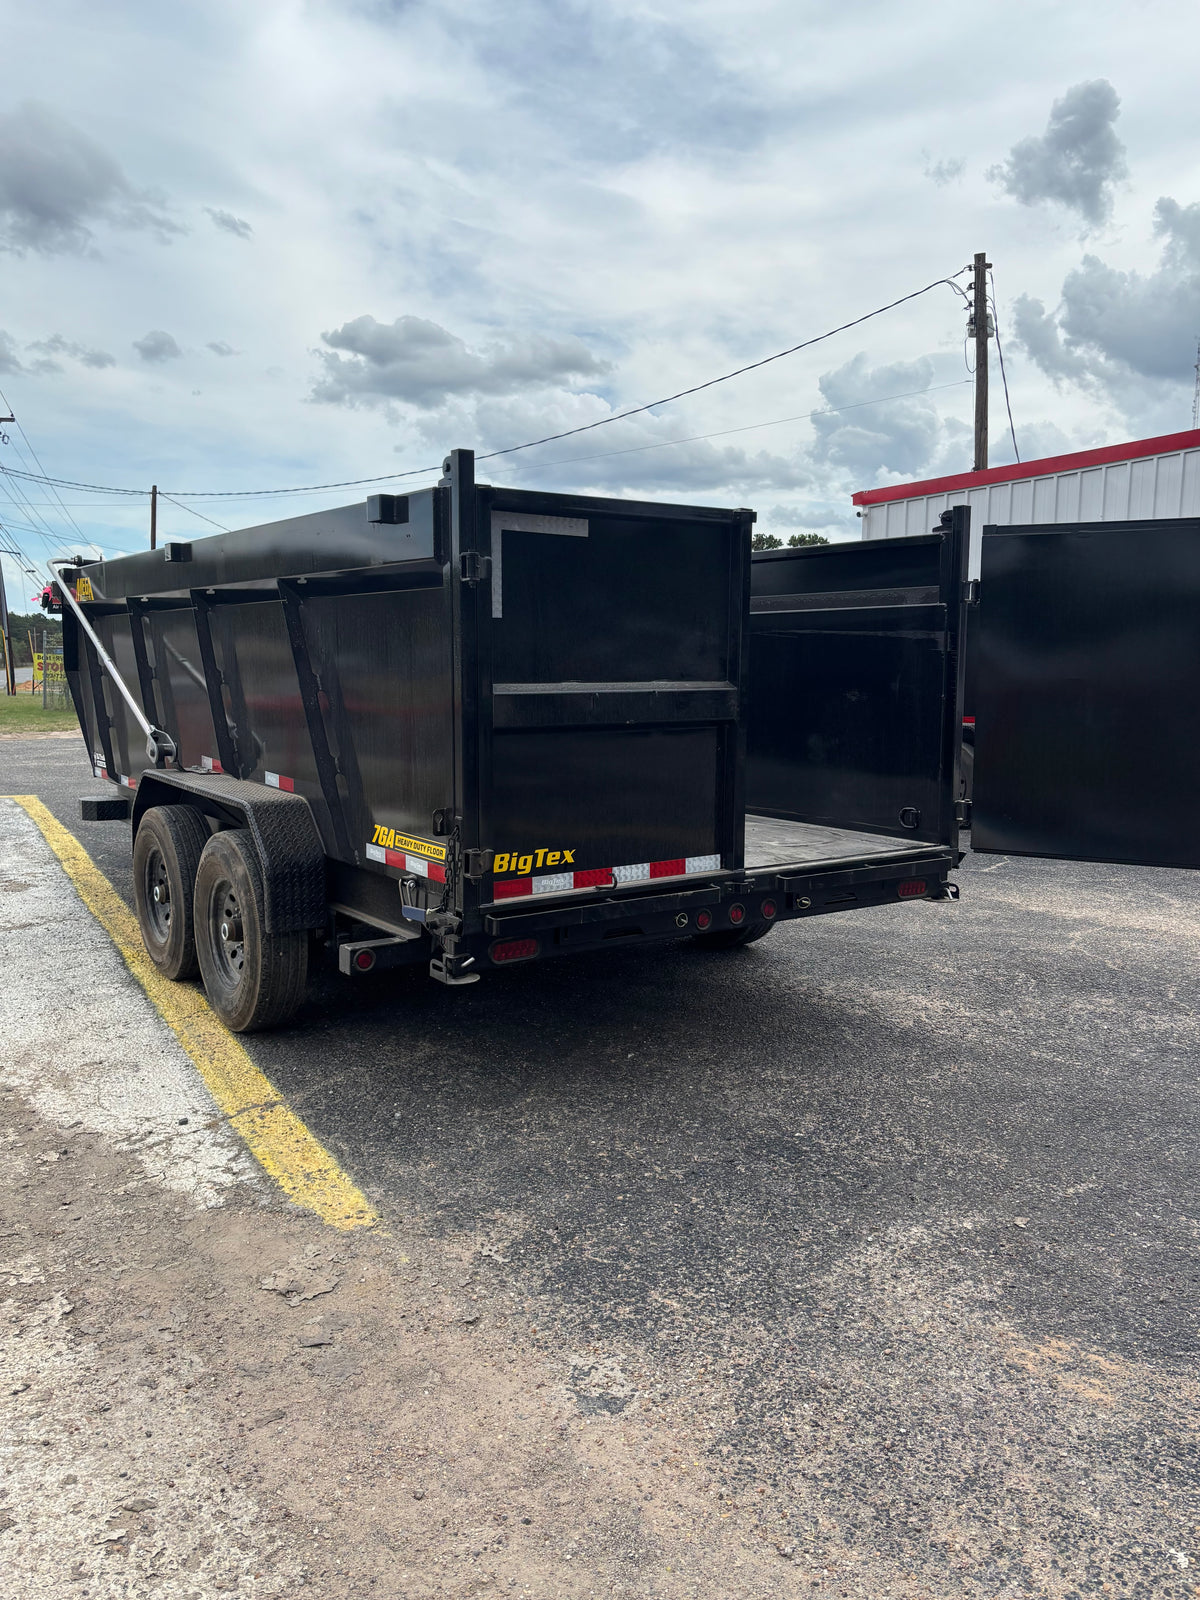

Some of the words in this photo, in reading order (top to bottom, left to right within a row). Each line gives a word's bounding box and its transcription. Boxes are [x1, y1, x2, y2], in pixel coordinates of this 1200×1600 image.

[372, 824, 395, 848] 7GA
[397, 837, 412, 848] HEAVY
[414, 842, 427, 852] DUTY
[427, 847, 444, 857] FLOOR
